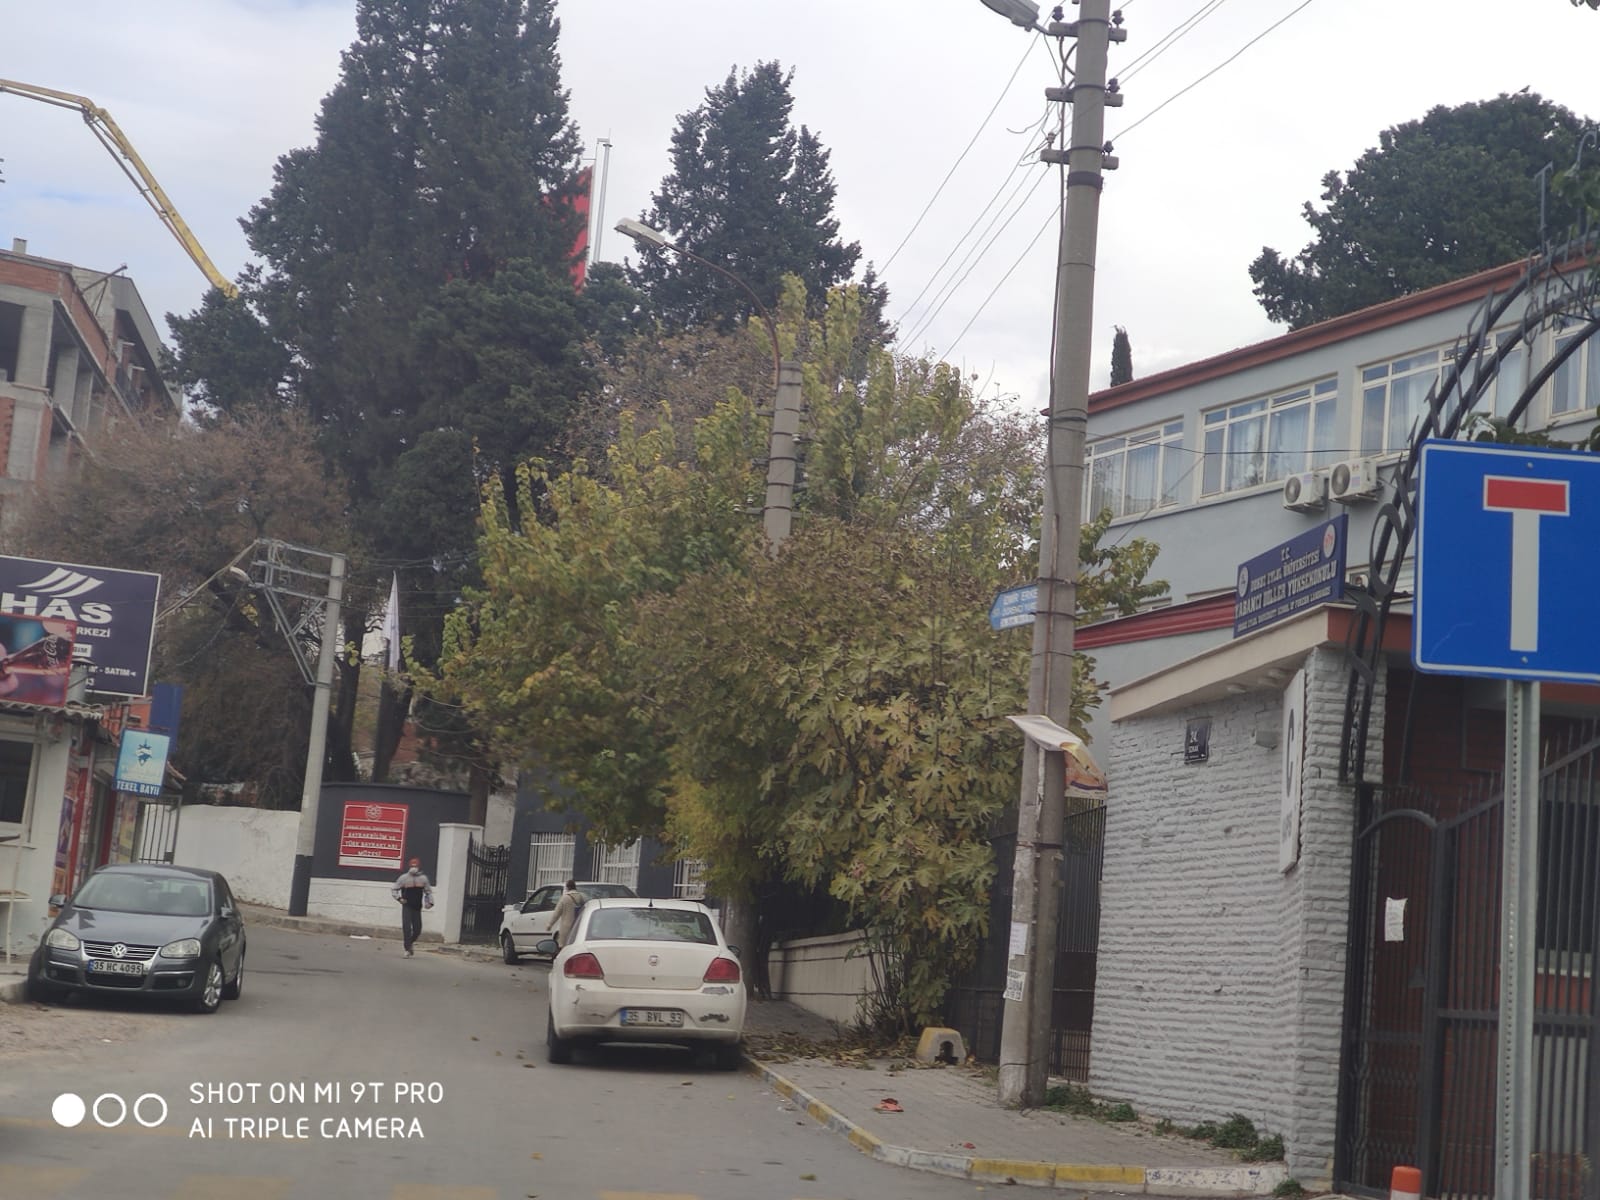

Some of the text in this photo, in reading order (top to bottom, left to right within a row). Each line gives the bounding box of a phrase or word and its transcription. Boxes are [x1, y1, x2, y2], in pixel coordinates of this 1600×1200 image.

[76, 627, 111, 638] RKEZİ
[94, 961, 141, 974] 35 HC 4095
